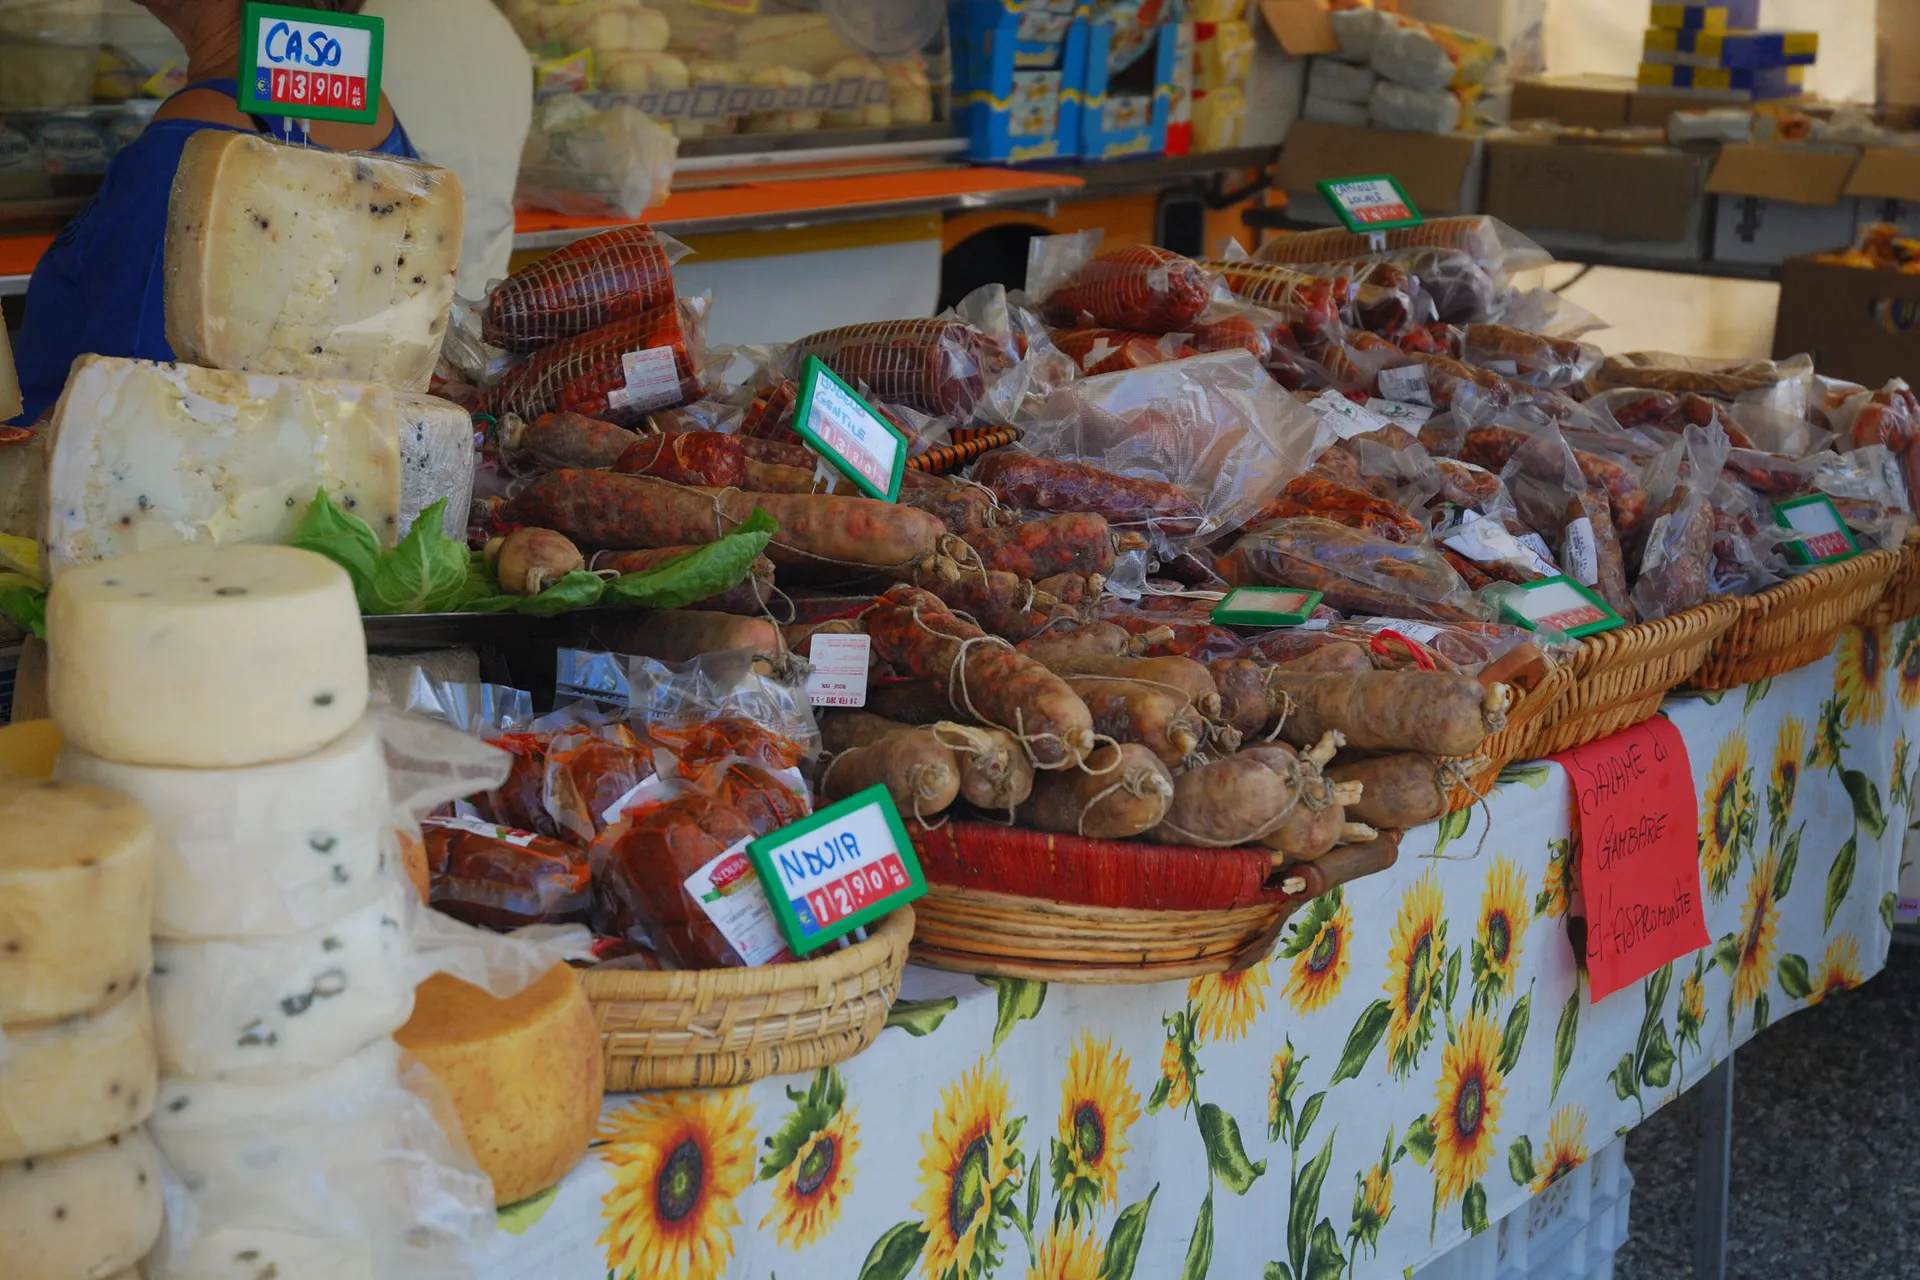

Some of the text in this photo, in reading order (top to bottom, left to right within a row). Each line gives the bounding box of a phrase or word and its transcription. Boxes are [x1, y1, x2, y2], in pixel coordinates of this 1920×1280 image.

[265, 21, 342, 67] CASO
[815, 391, 866, 442] GENTILE
[1571, 743, 1647, 816] SALAME
